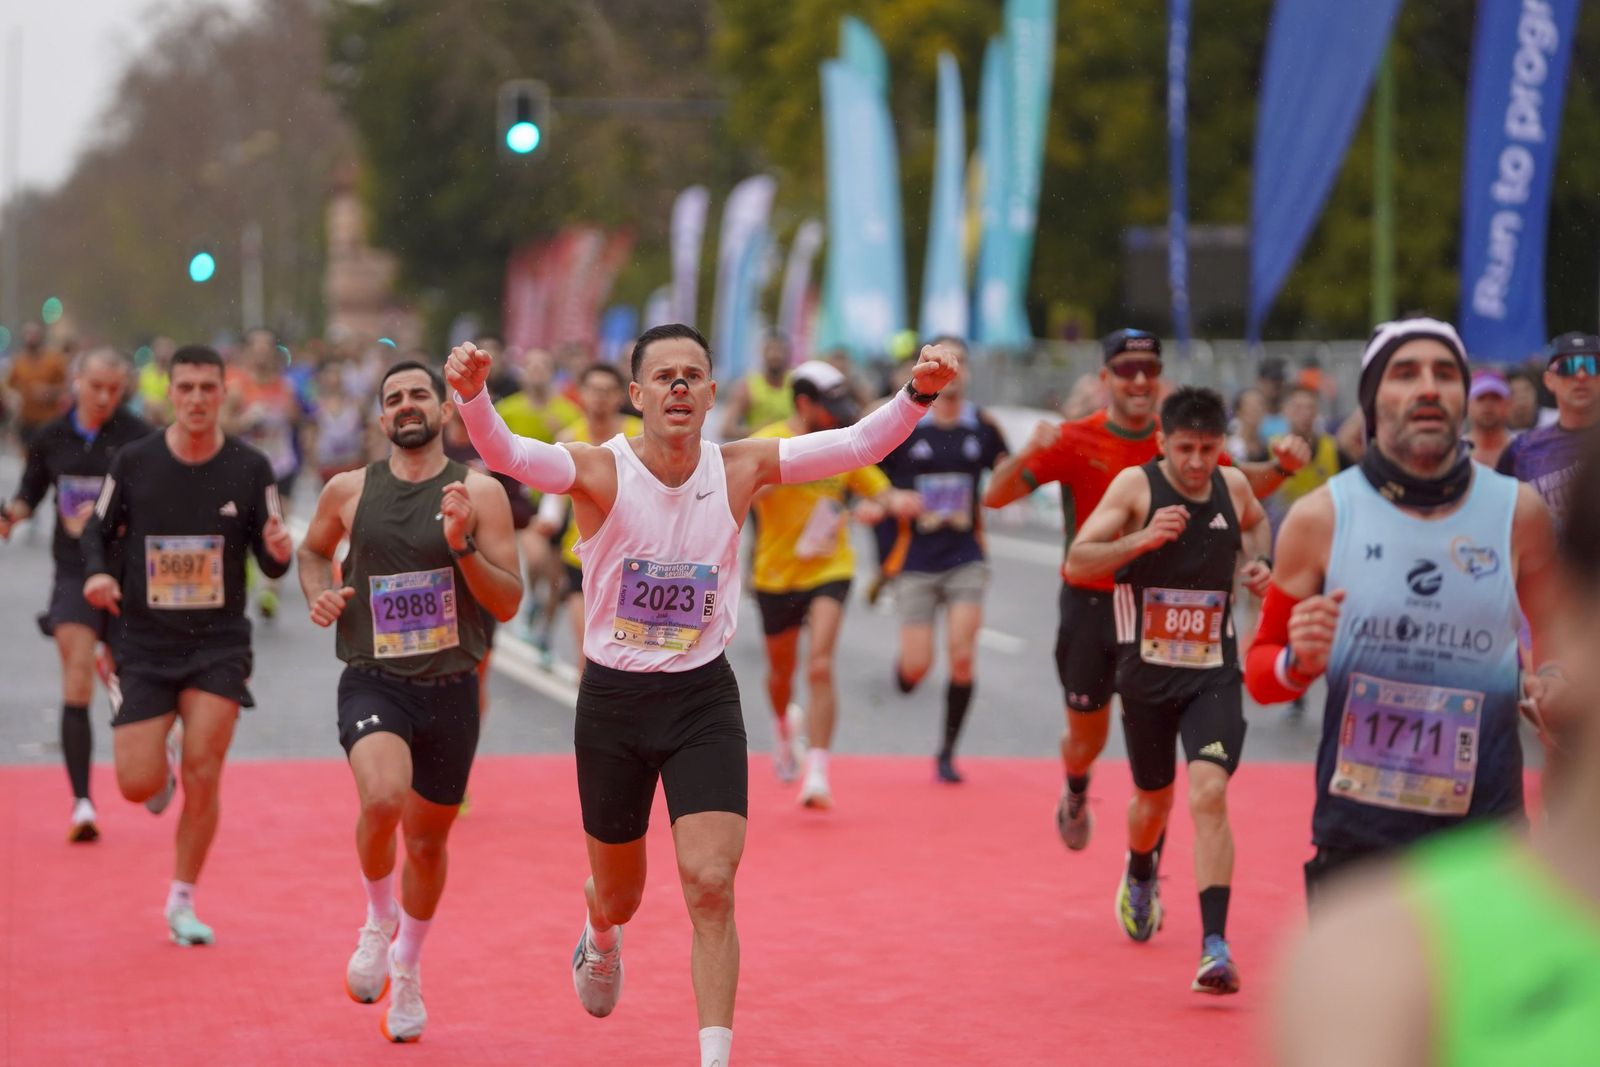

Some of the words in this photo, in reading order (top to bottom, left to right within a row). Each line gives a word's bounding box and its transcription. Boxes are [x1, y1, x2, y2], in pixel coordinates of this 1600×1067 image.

[1490, 145, 1535, 204] to
[1473, 210, 1523, 319] Run
[160, 553, 206, 576] 5697
[383, 592, 438, 620] 2988
[632, 581, 695, 612] 2023
[1165, 608, 1205, 634] 808
[1426, 621, 1493, 653] PELAO
[1365, 711, 1443, 756] 1711
